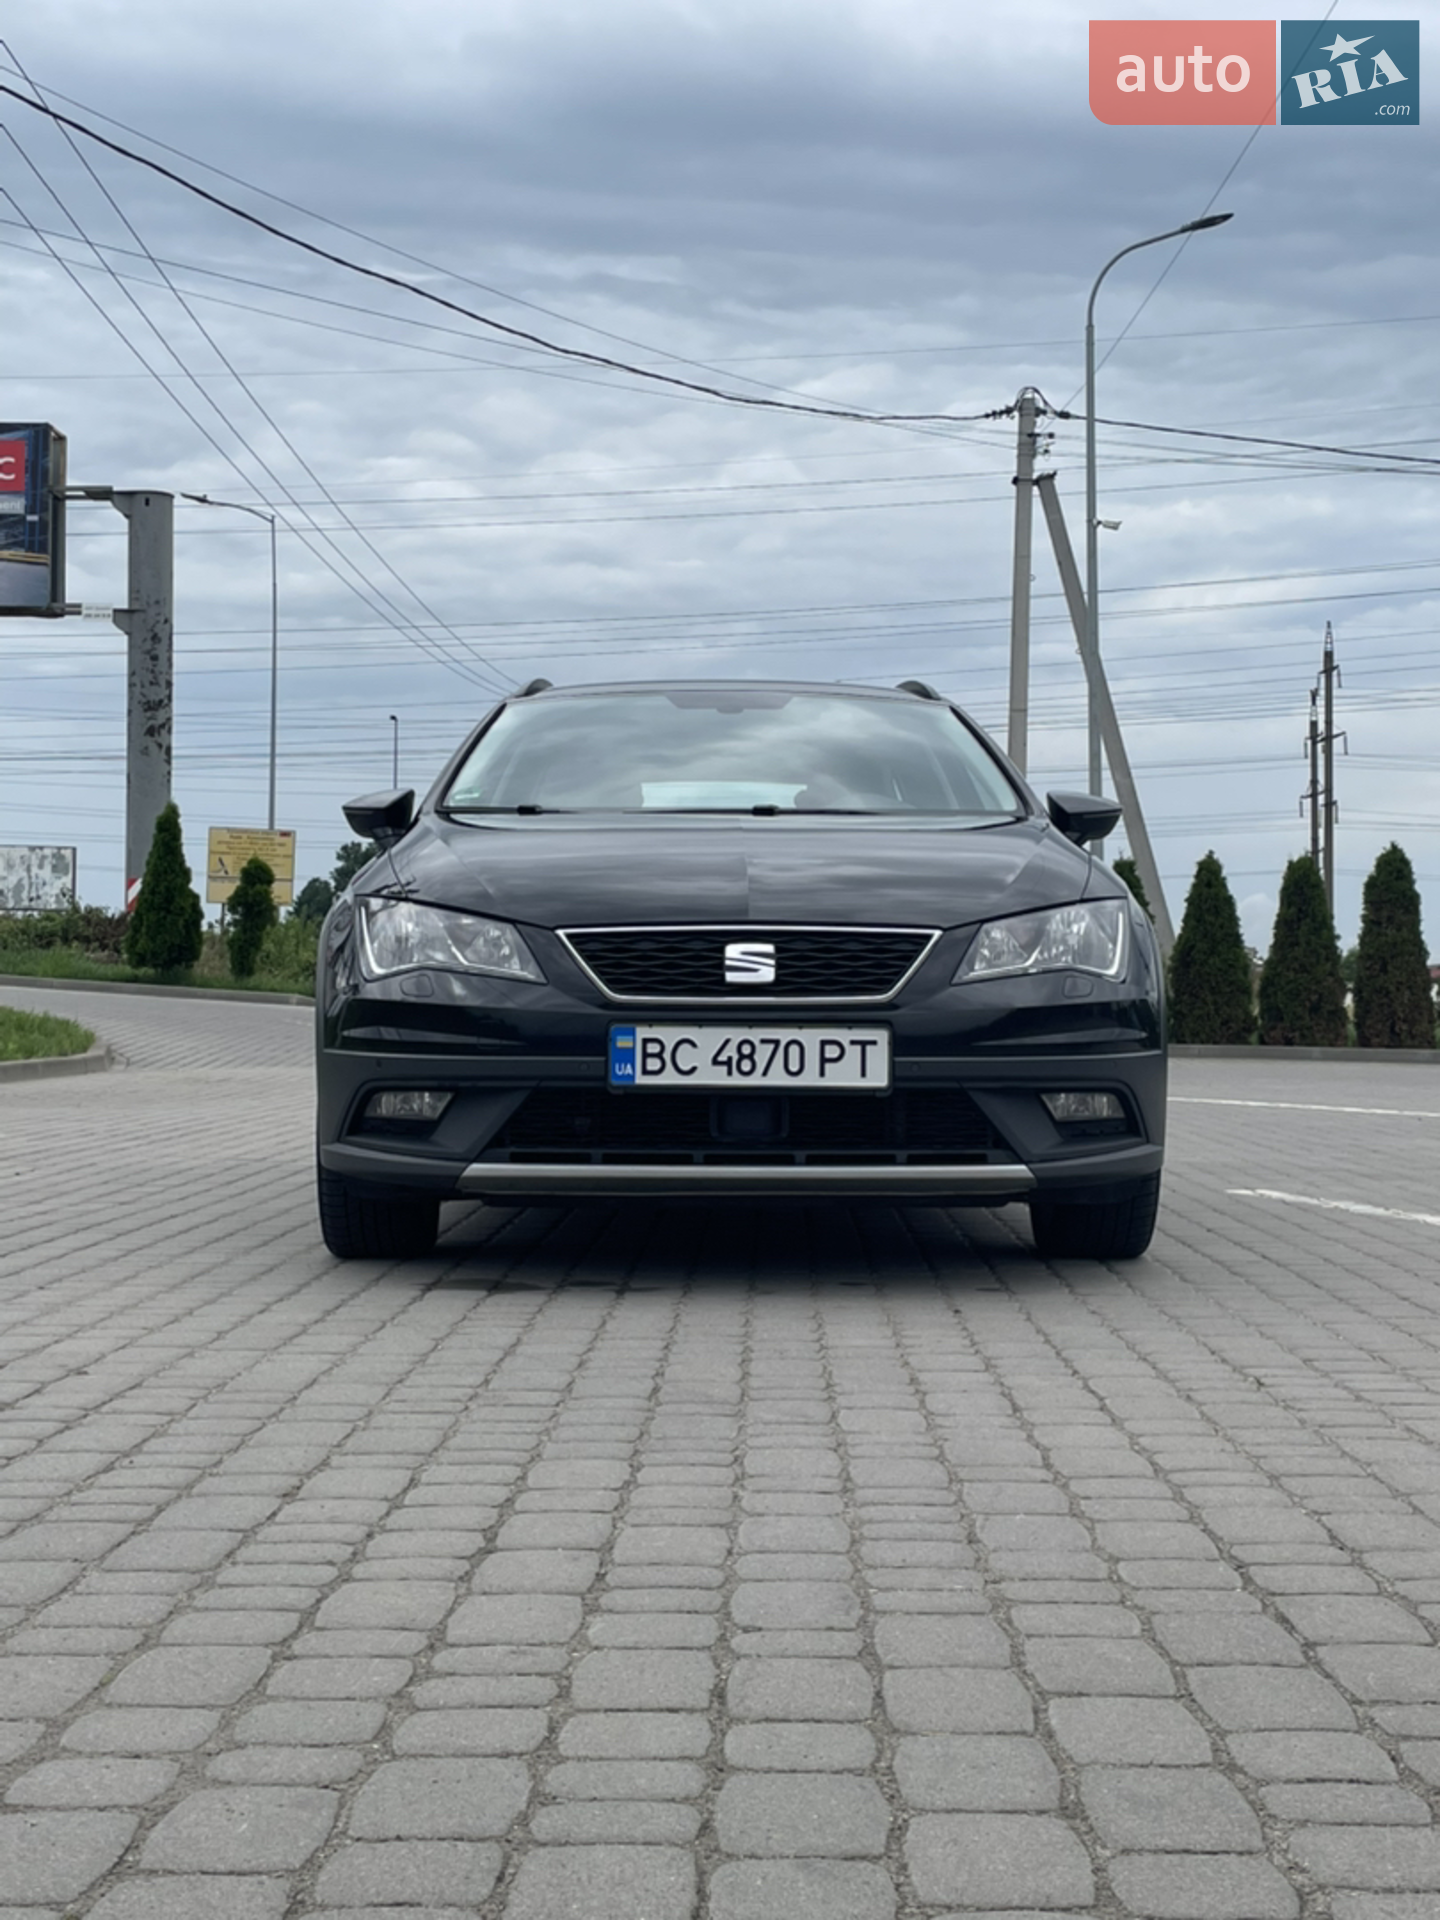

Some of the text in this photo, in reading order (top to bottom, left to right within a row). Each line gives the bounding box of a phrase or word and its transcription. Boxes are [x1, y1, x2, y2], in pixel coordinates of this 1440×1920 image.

[615, 1063, 633, 1076] UA
[641, 1037, 878, 1078] BC 4870 PT
